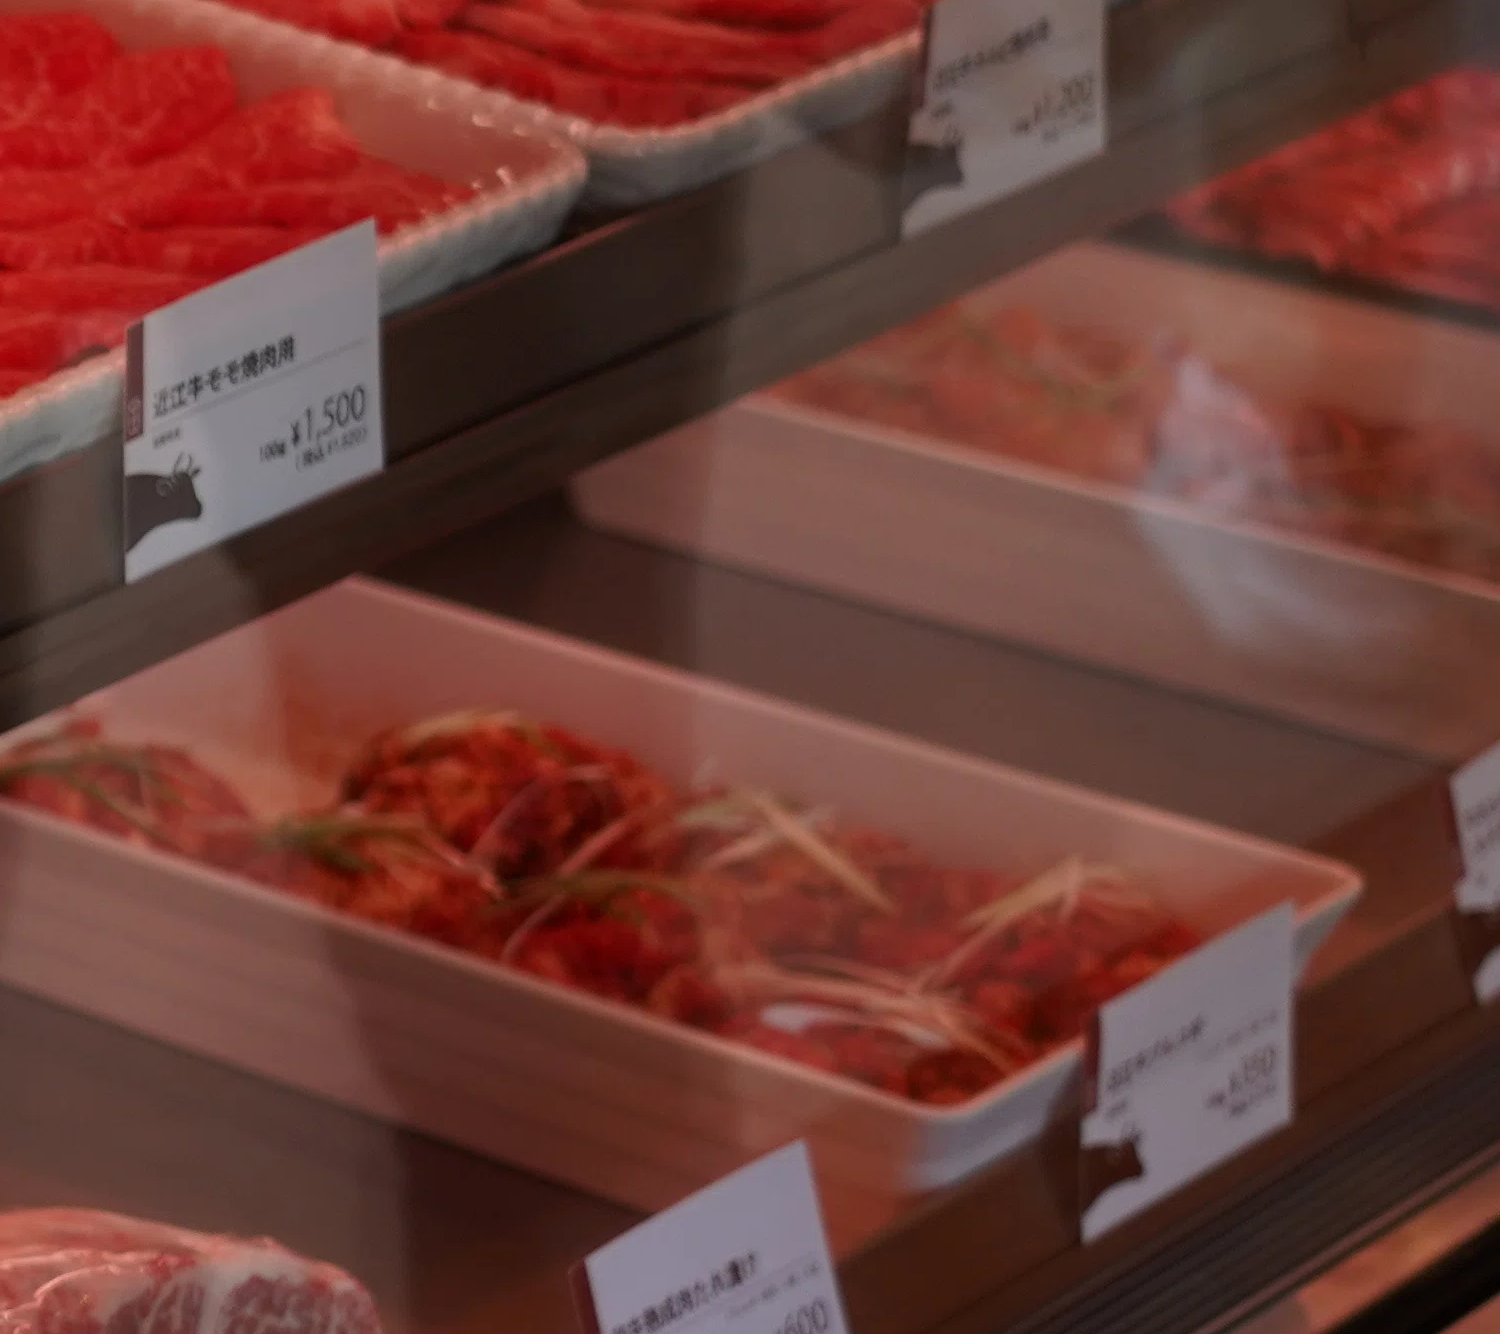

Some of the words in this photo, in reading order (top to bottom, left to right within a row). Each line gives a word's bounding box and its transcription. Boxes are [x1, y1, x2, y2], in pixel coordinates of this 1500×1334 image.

[152, 334, 295, 417] 近江牛モモ焼肉用
[291, 384, 366, 447] ¥1,500
